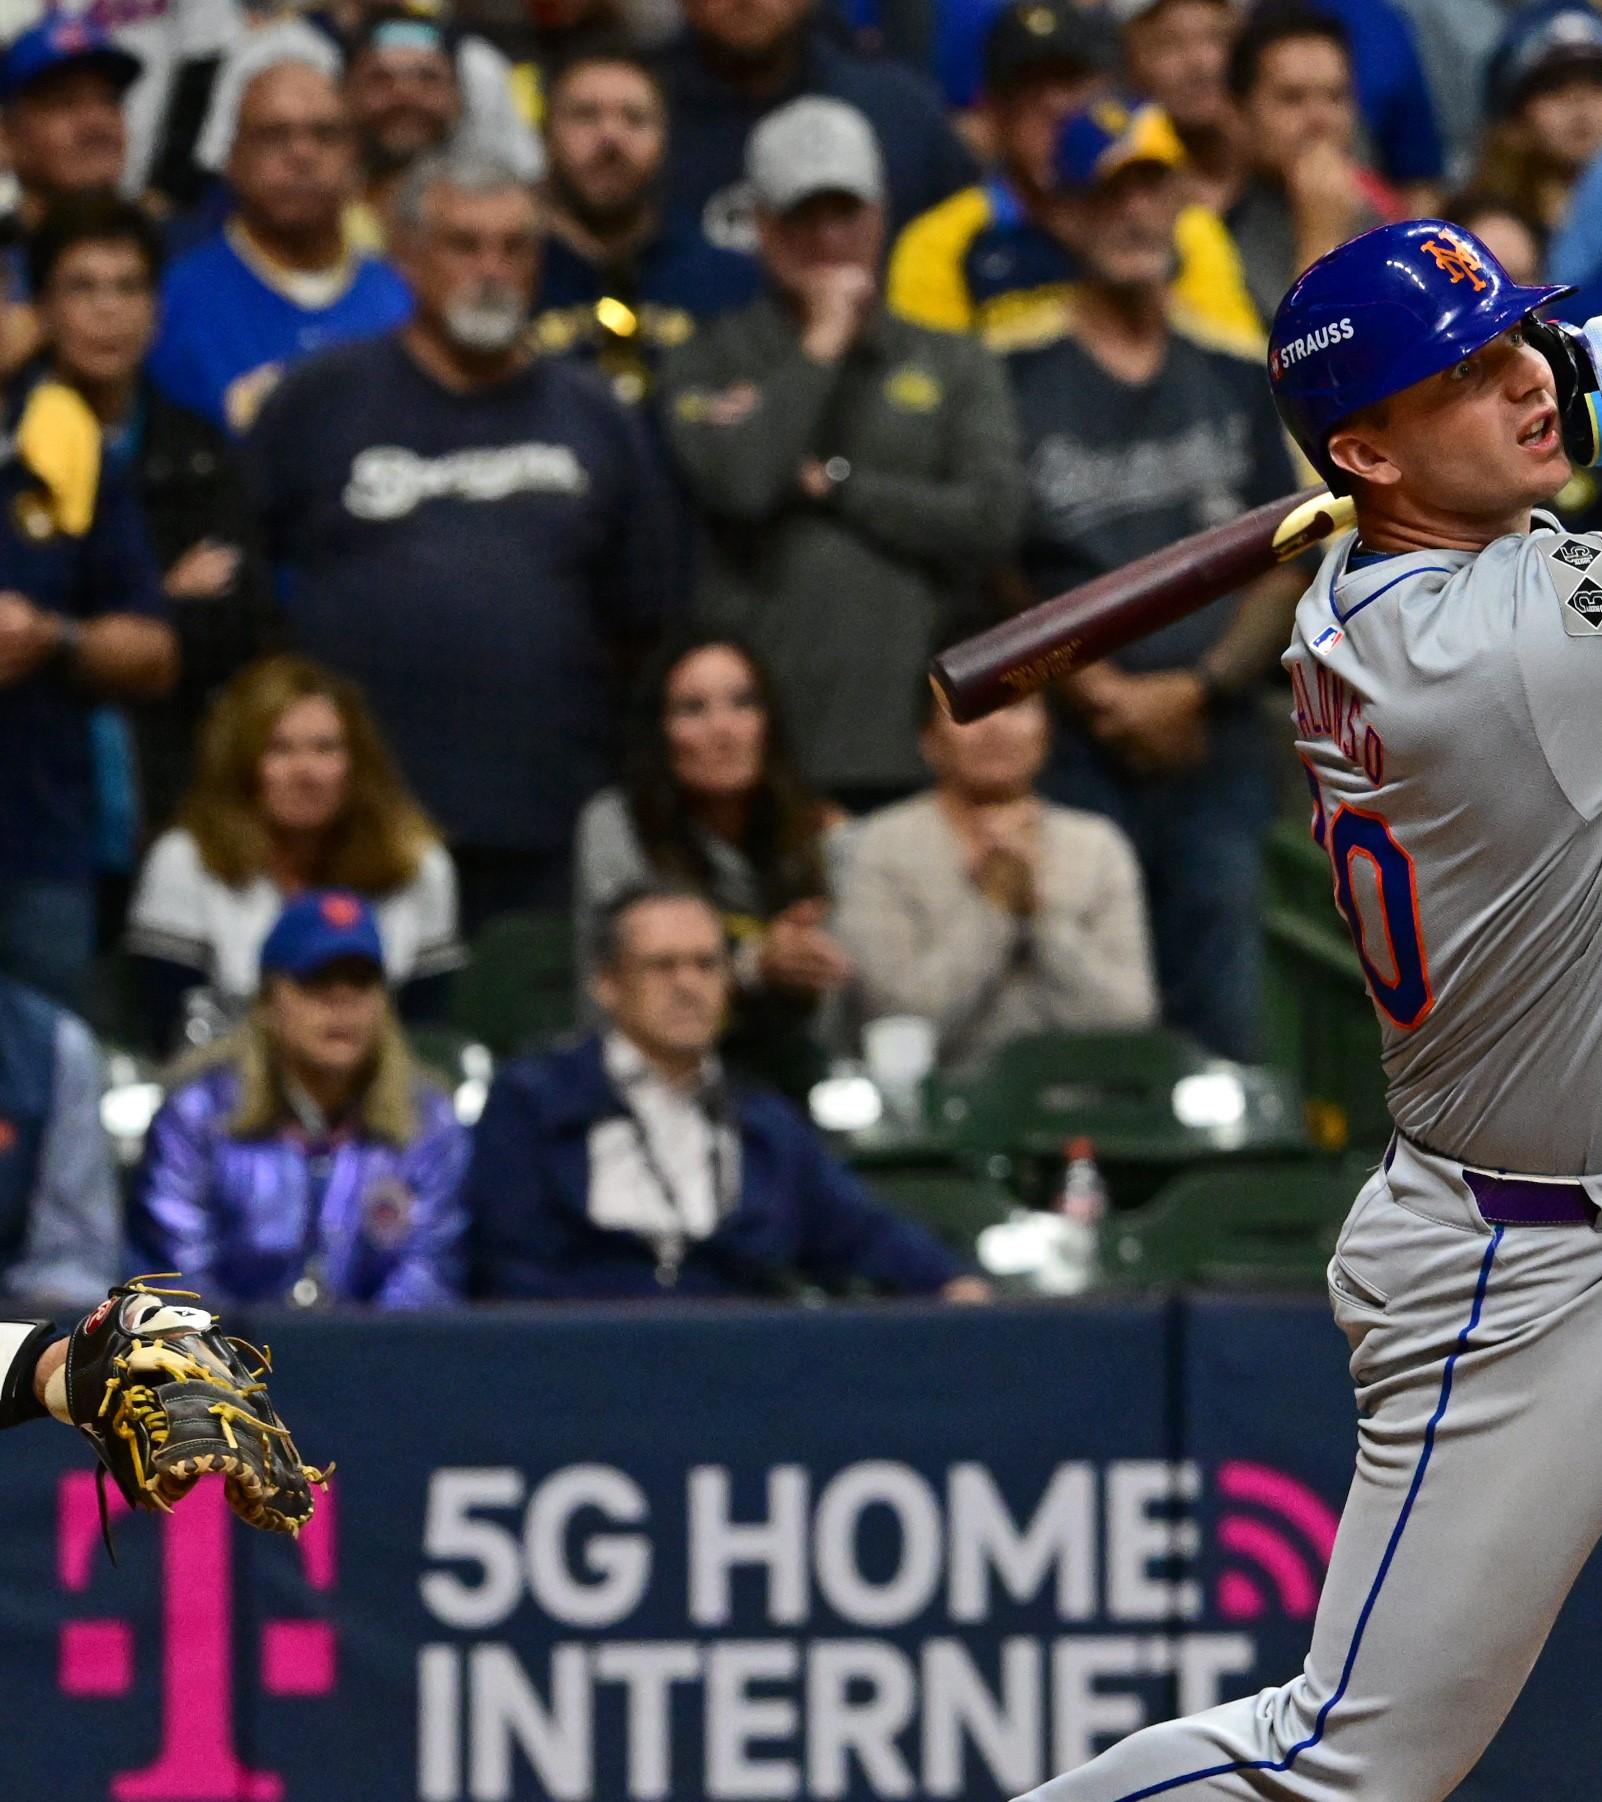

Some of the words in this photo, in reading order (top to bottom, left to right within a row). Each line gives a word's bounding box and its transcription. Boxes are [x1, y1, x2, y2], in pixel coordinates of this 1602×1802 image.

[1280, 317, 1355, 369] STRAUSS
[419, 1461, 652, 1629] 5G
[687, 1460, 1201, 1627] HOME
